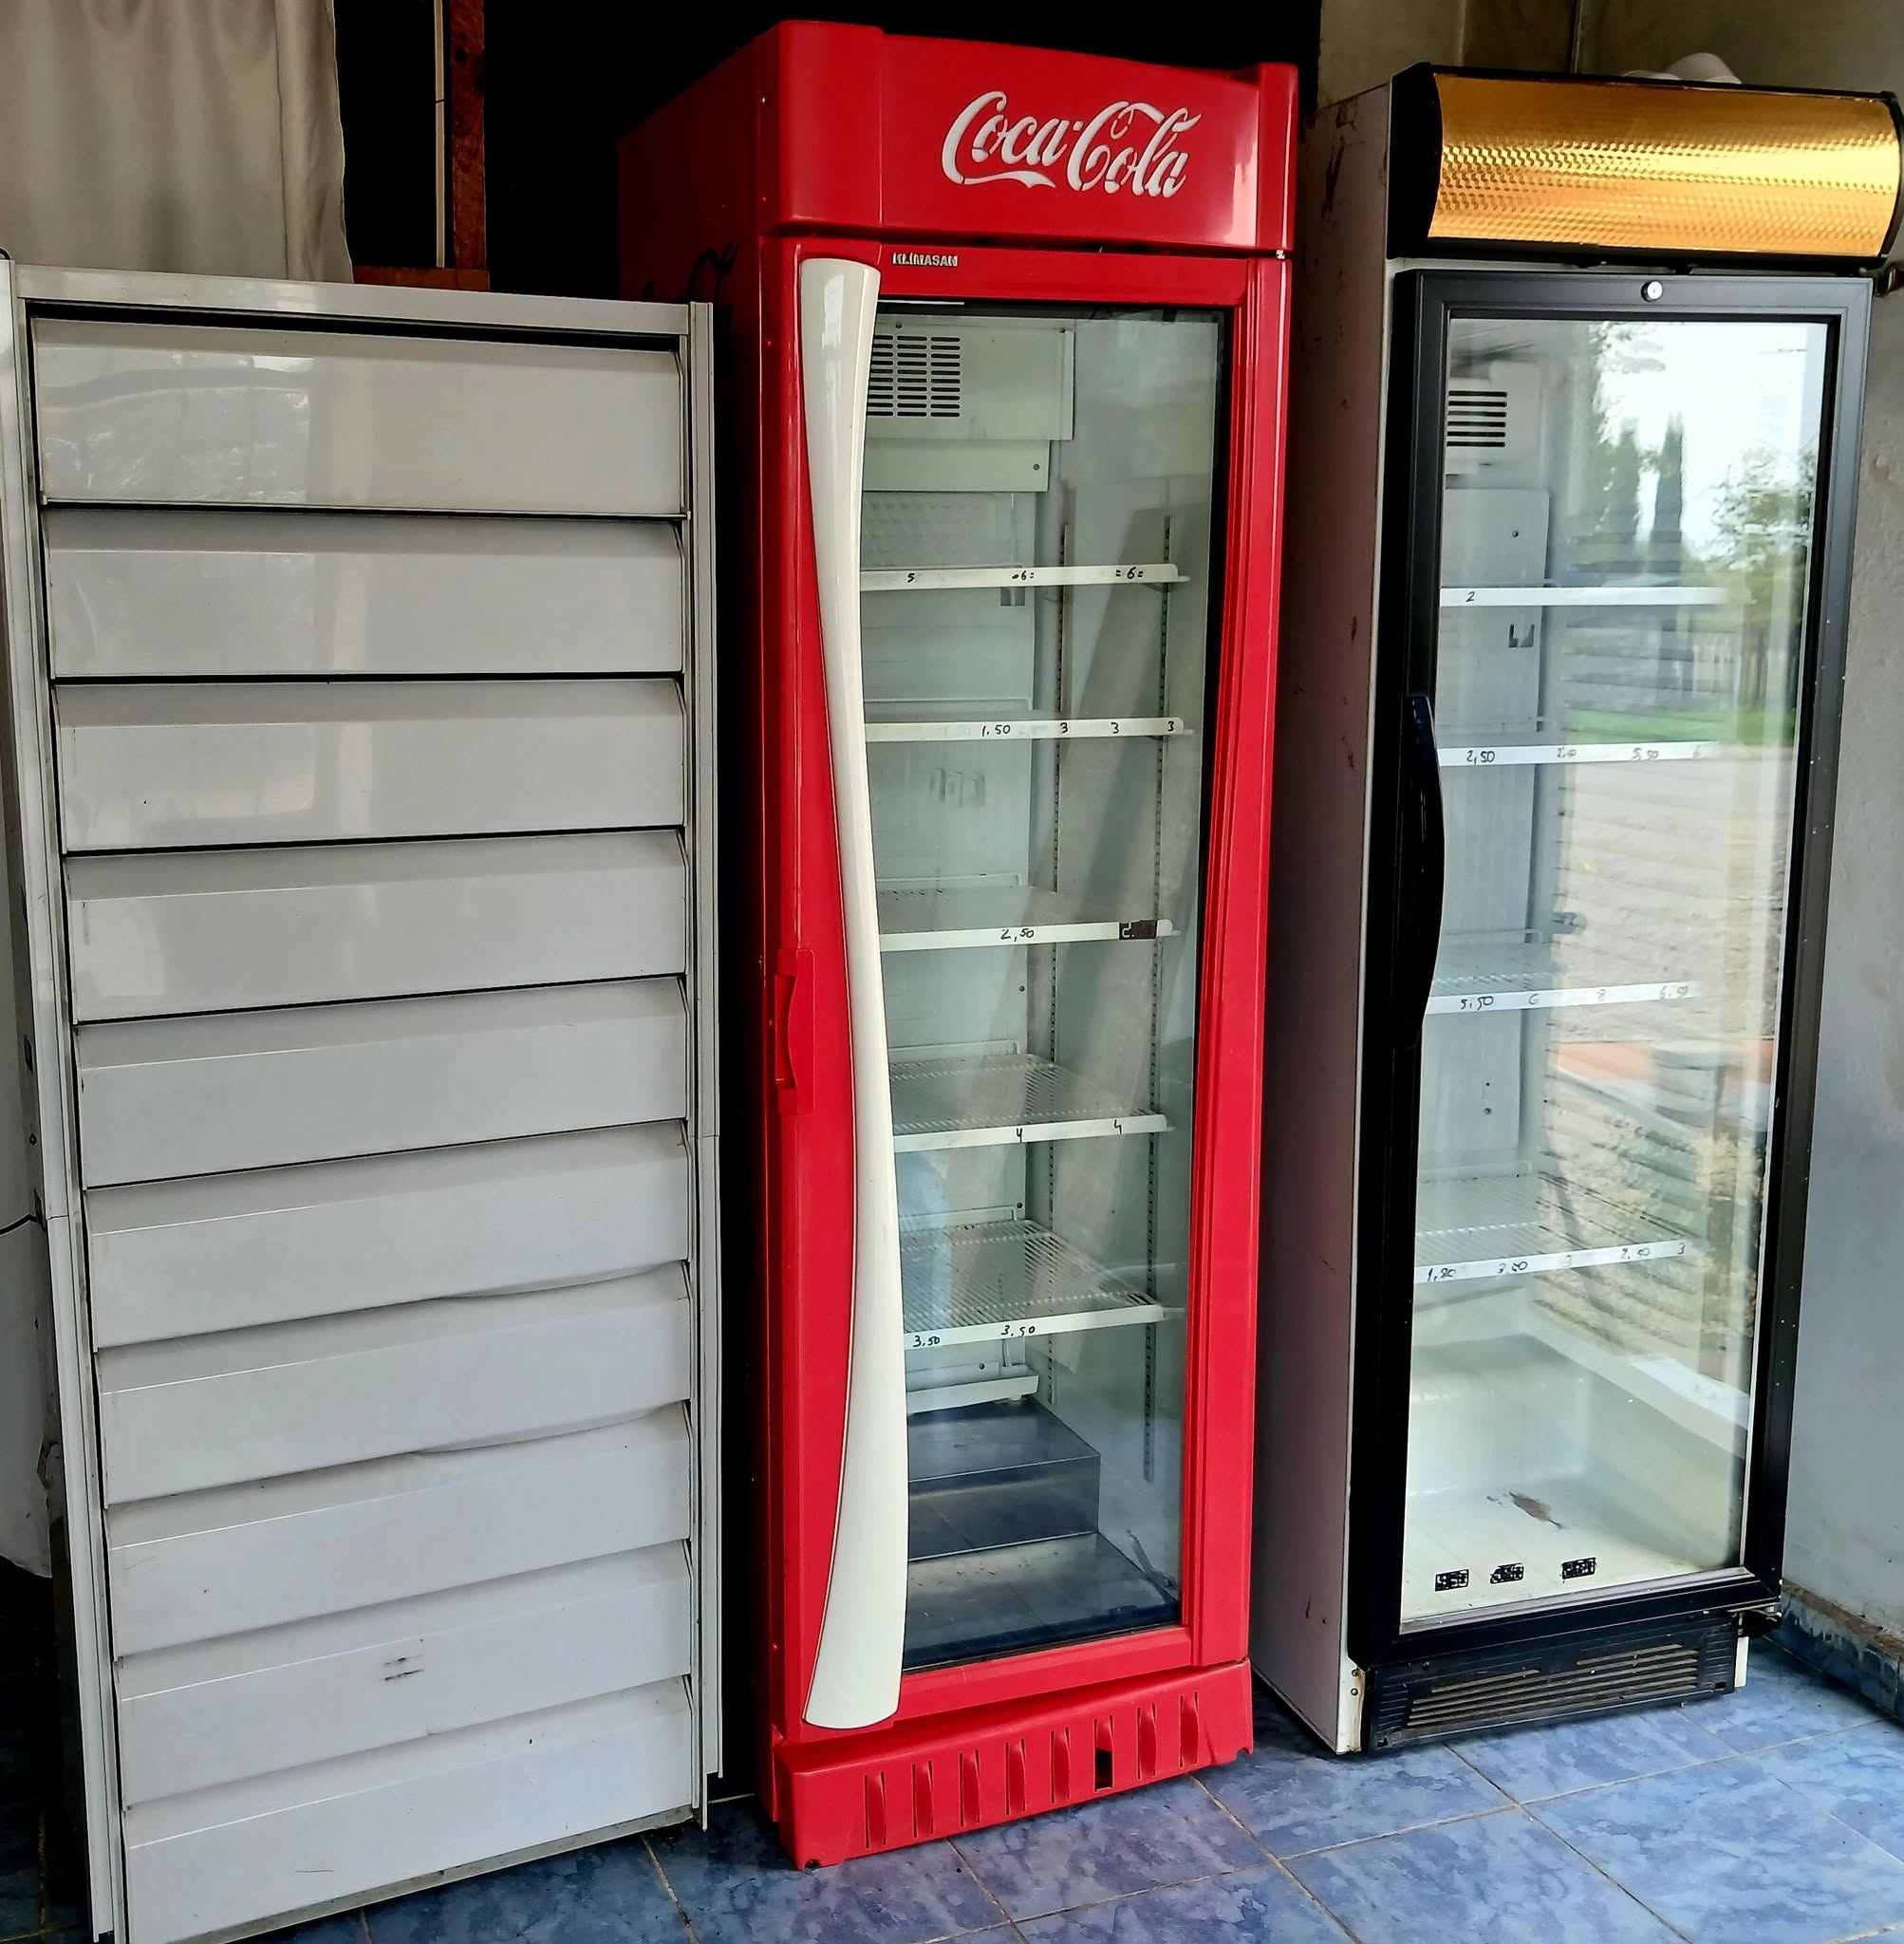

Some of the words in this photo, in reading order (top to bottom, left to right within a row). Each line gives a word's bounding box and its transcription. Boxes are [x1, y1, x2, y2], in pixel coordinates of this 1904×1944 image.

[1465, 591, 1475, 602] 2
[1060, 722, 1069, 733] 3
[1111, 721, 1119, 734] 3
[1167, 720, 1175, 732] 3
[1000, 927, 1035, 943] 2,50
[1017, 1128, 1023, 1143] 4
